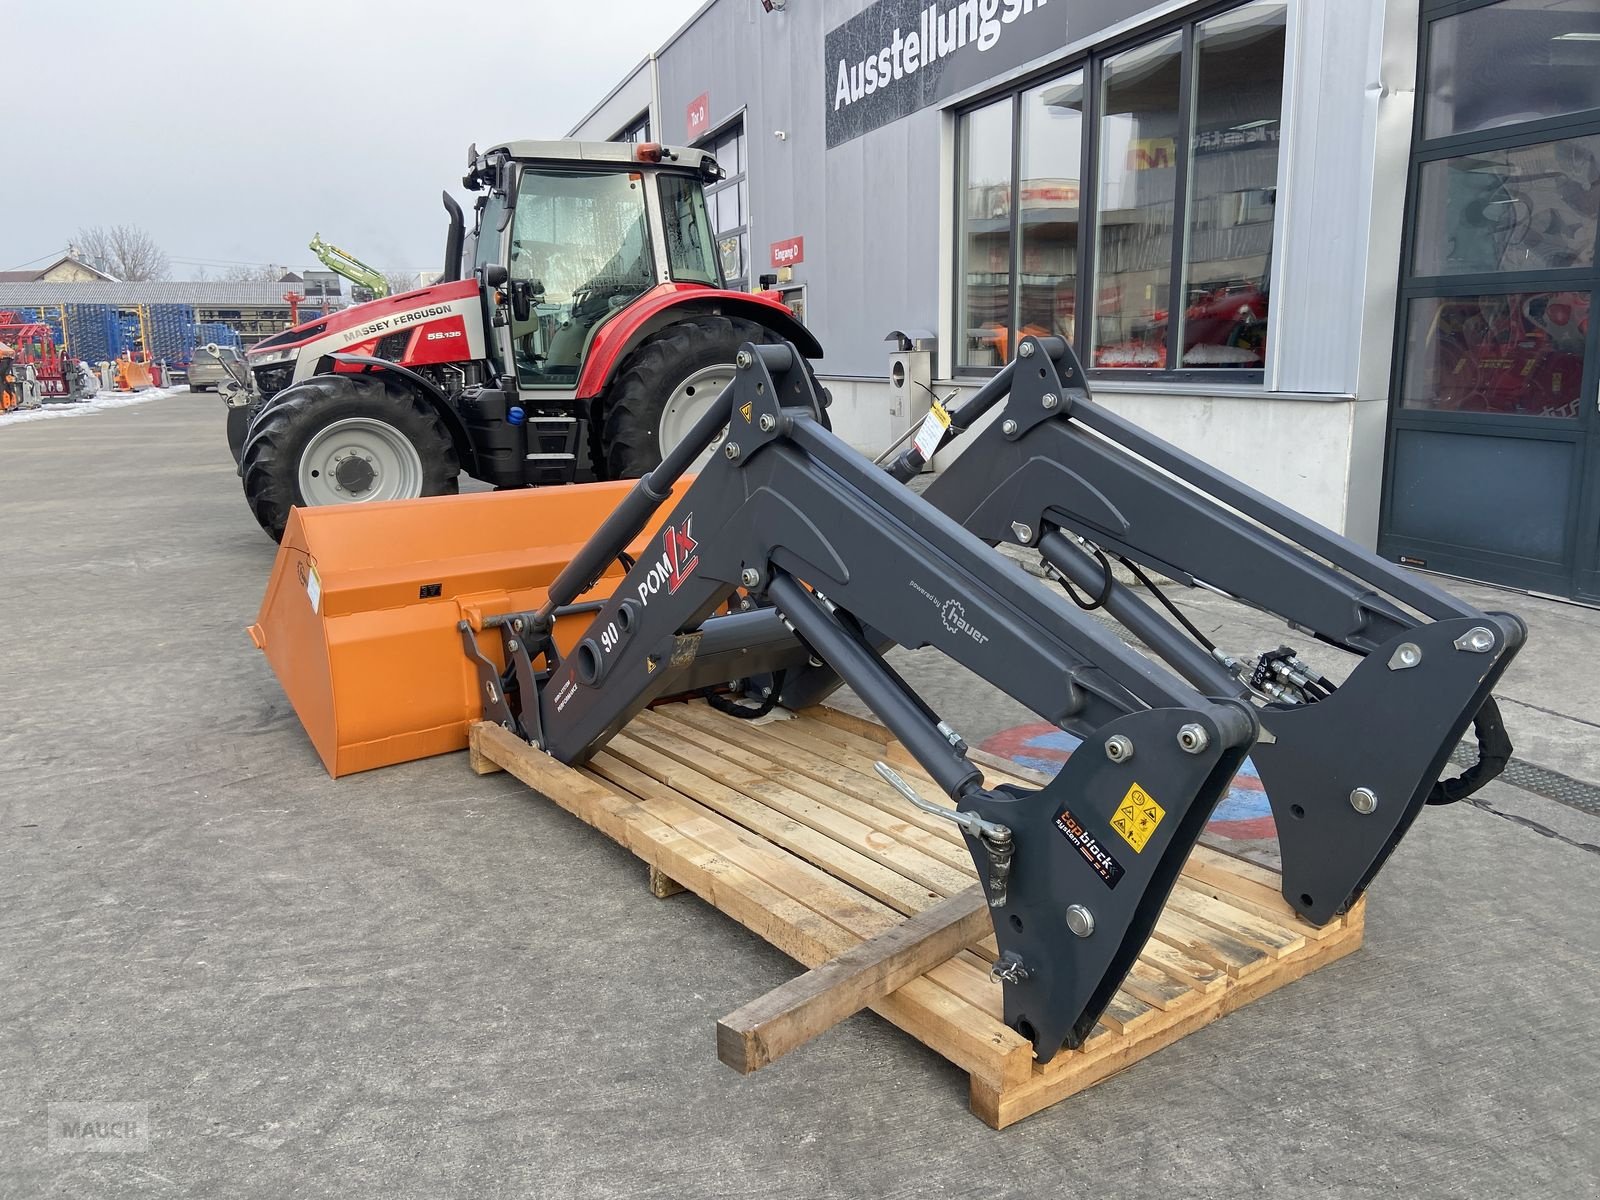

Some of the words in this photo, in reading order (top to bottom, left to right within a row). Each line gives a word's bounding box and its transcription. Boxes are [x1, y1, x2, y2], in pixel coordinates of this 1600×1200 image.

[834, 0, 1048, 112] Ausstellungs
[691, 111, 699, 127] Tor
[699, 106, 704, 121] D
[775, 248, 793, 261] Eingang
[793, 244, 799, 256] D
[343, 320, 390, 342] MASSEY
[393, 304, 452, 326] FERGUSON
[427, 331, 462, 341] 5S.135
[909, 580, 934, 601] powered
[932, 596, 941, 608] by
[601, 622, 619, 653] 90
[947, 606, 990, 644] hauer
[1055, 818, 1081, 847] system
